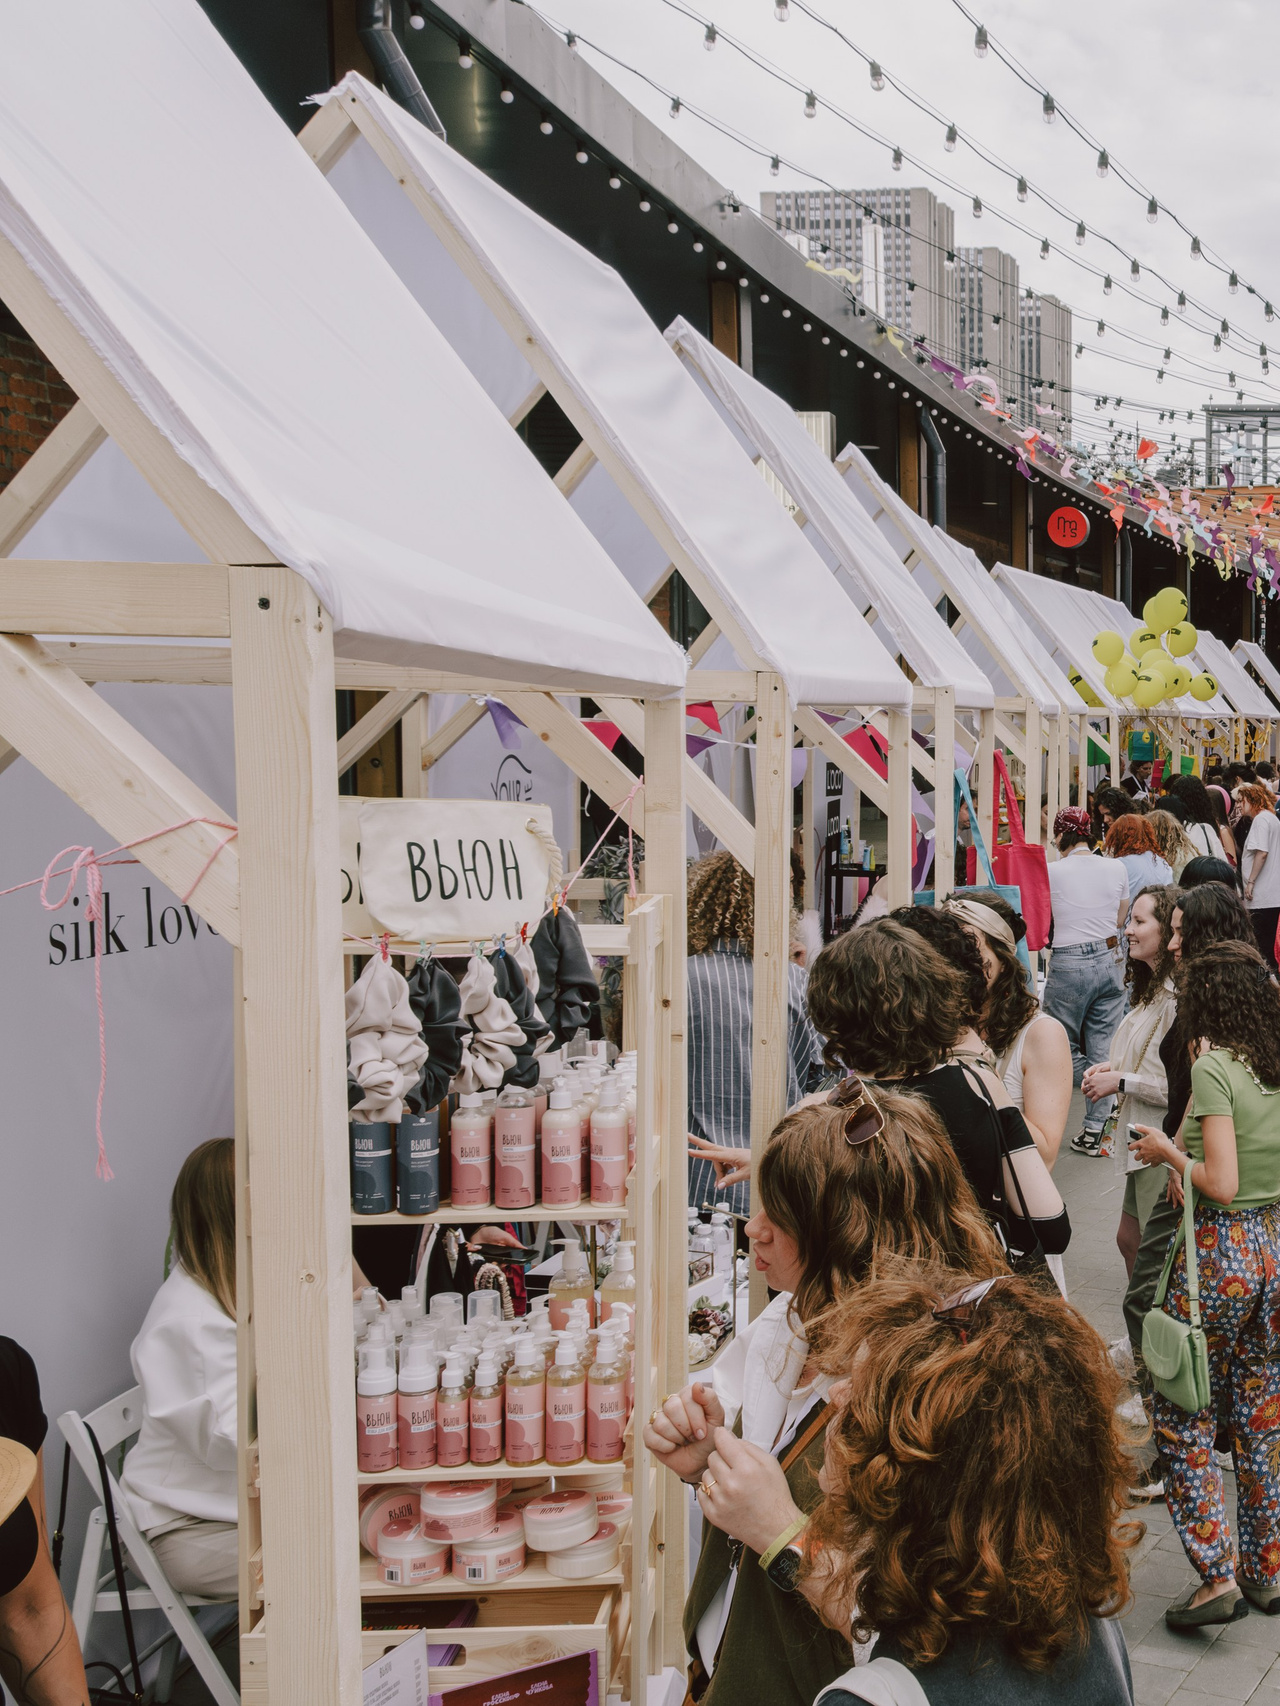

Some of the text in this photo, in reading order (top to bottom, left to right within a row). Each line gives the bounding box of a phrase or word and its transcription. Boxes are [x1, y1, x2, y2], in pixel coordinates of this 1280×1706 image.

[406, 838, 523, 902] ВЬЮН
[49, 886, 220, 966] silk lov
[410, 1138, 431, 1151] ВЬЮН
[502, 1134, 521, 1146] ВЬЮН
[460, 1146, 480, 1158] ВЬЮН
[551, 1145, 570, 1157] ВЬЮН
[554, 1403, 573, 1415] ВЬЮН
[600, 1400, 619, 1414] ВЬЮН
[366, 1411, 391, 1427] ВЬЮН
[412, 1408, 435, 1425] ВЬЮН
[388, 1502, 413, 1521] ВЬЮН
